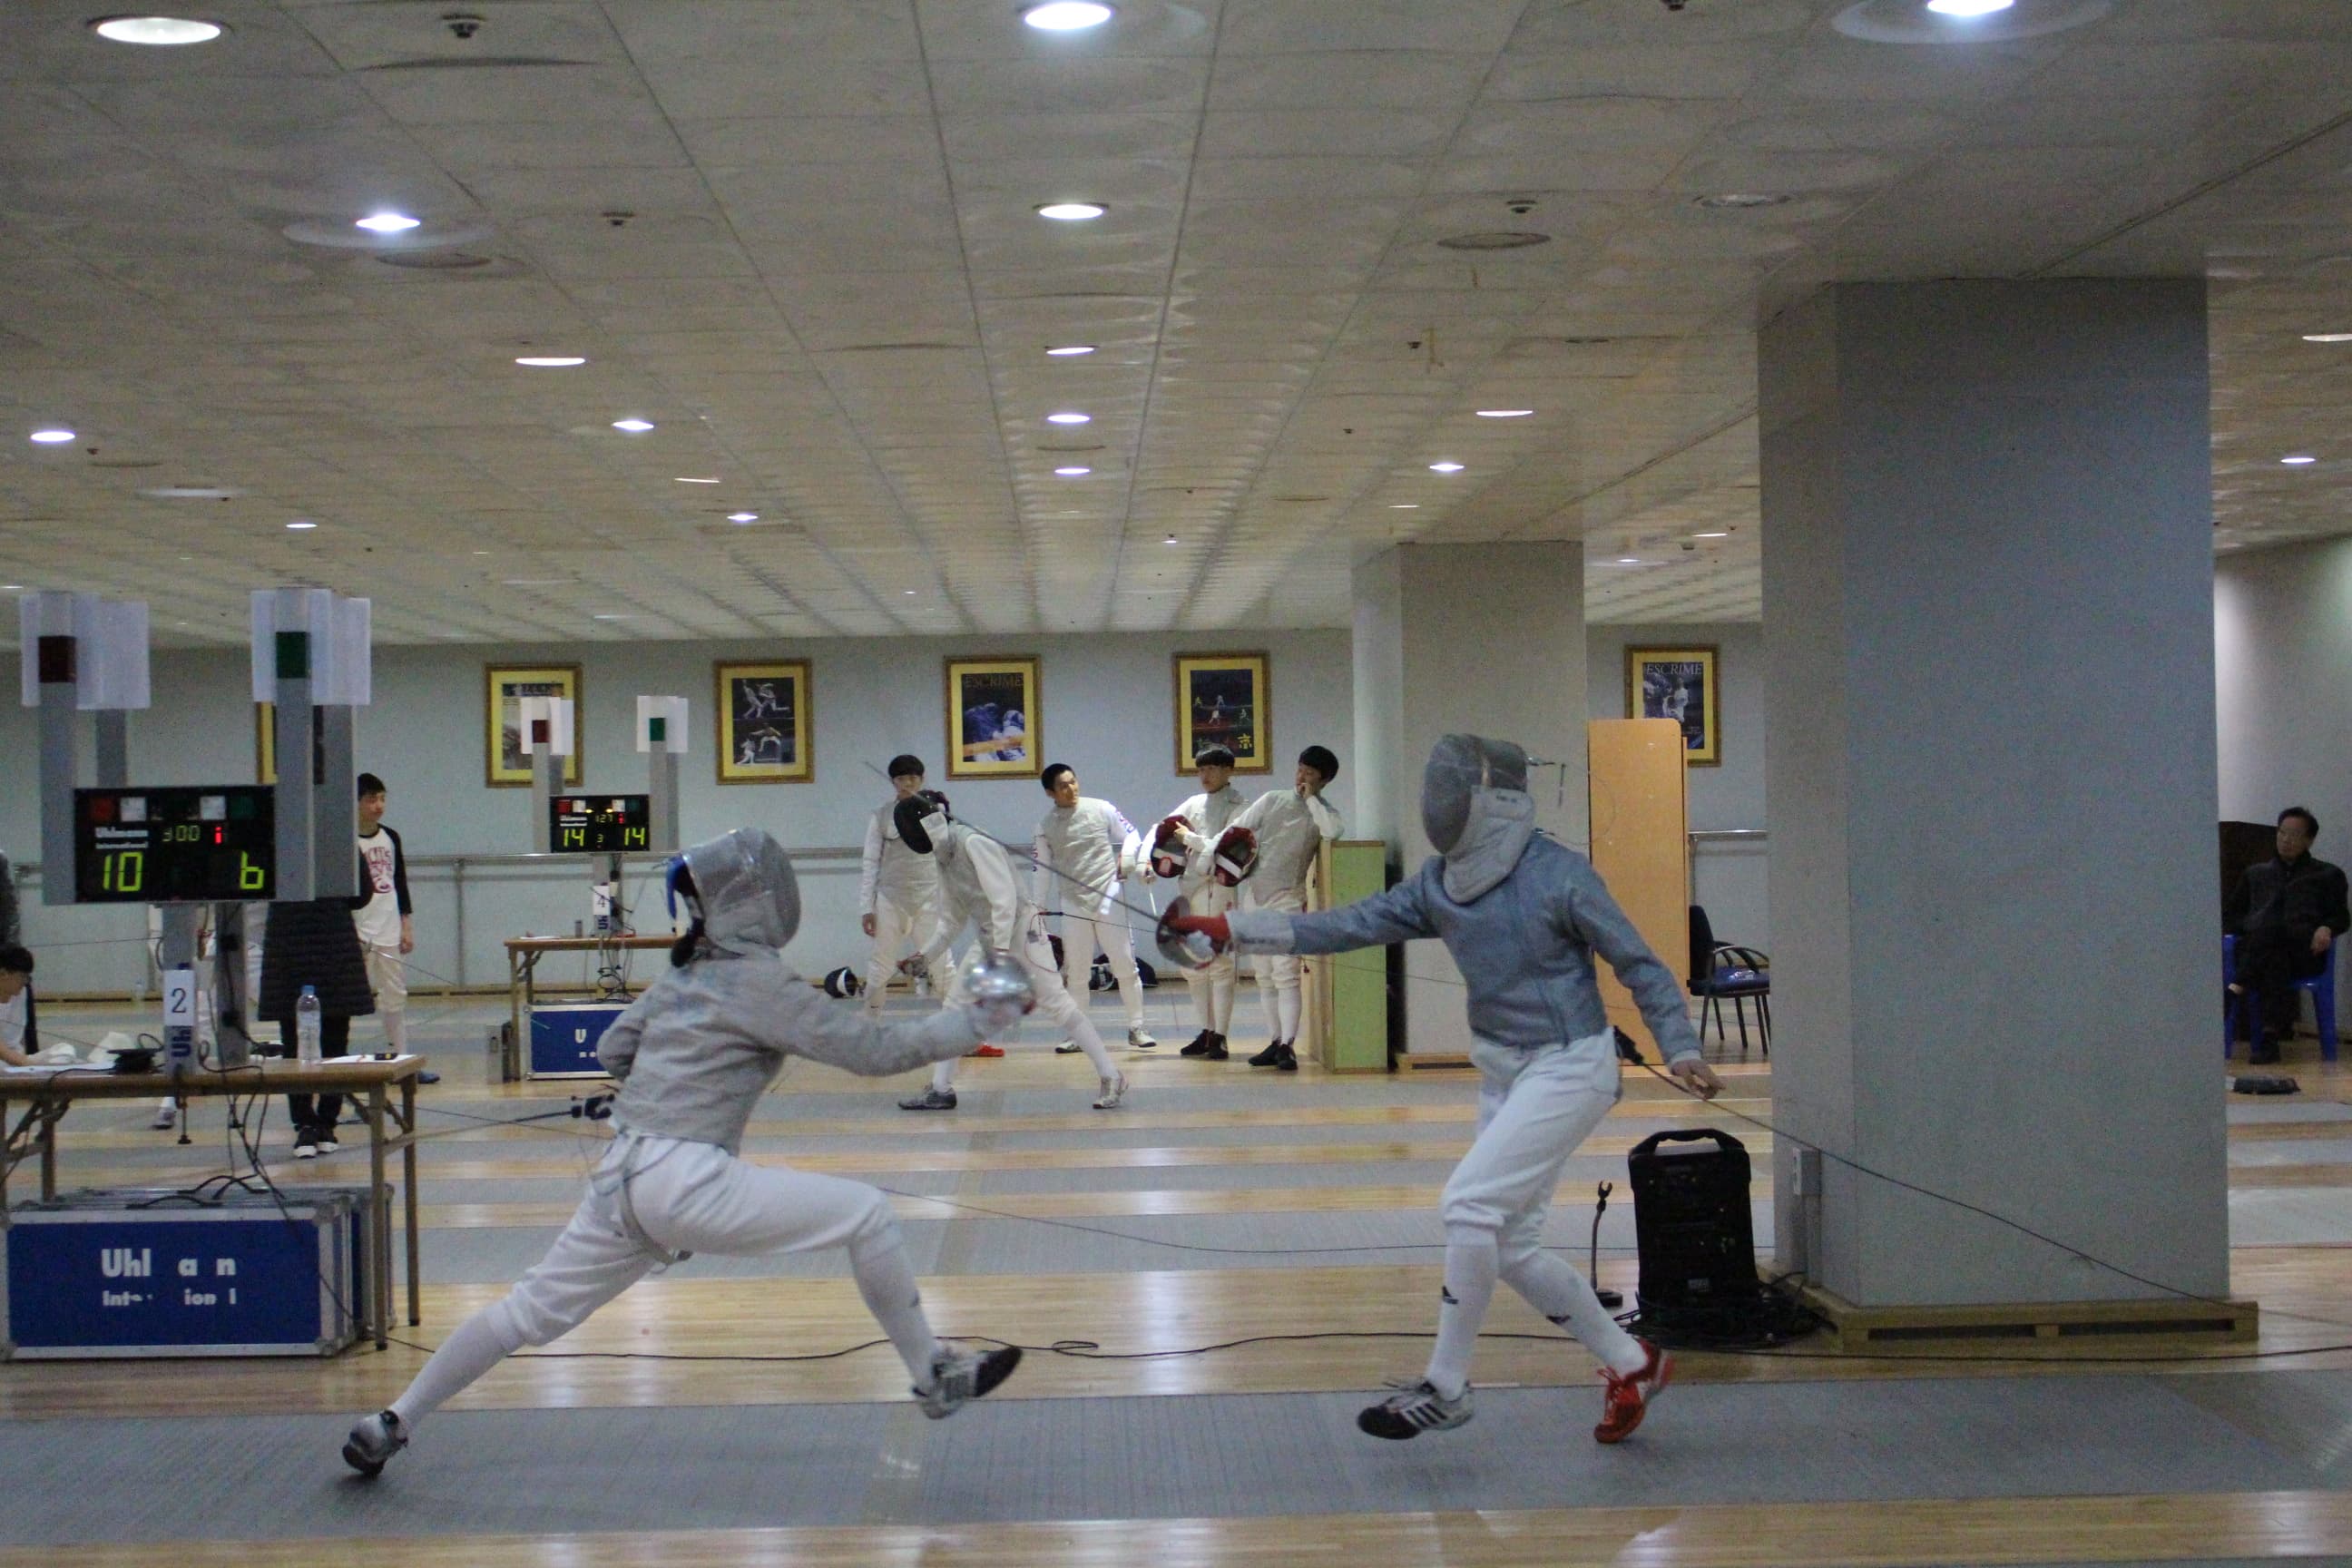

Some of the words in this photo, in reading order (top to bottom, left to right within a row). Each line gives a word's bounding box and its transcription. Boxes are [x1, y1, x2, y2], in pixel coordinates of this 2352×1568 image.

[1647, 663, 1702, 675] ESCRIME
[564, 828, 584, 848] 14
[624, 828, 645, 846] 14
[103, 851, 143, 891] 10
[171, 987, 187, 1014] 2
